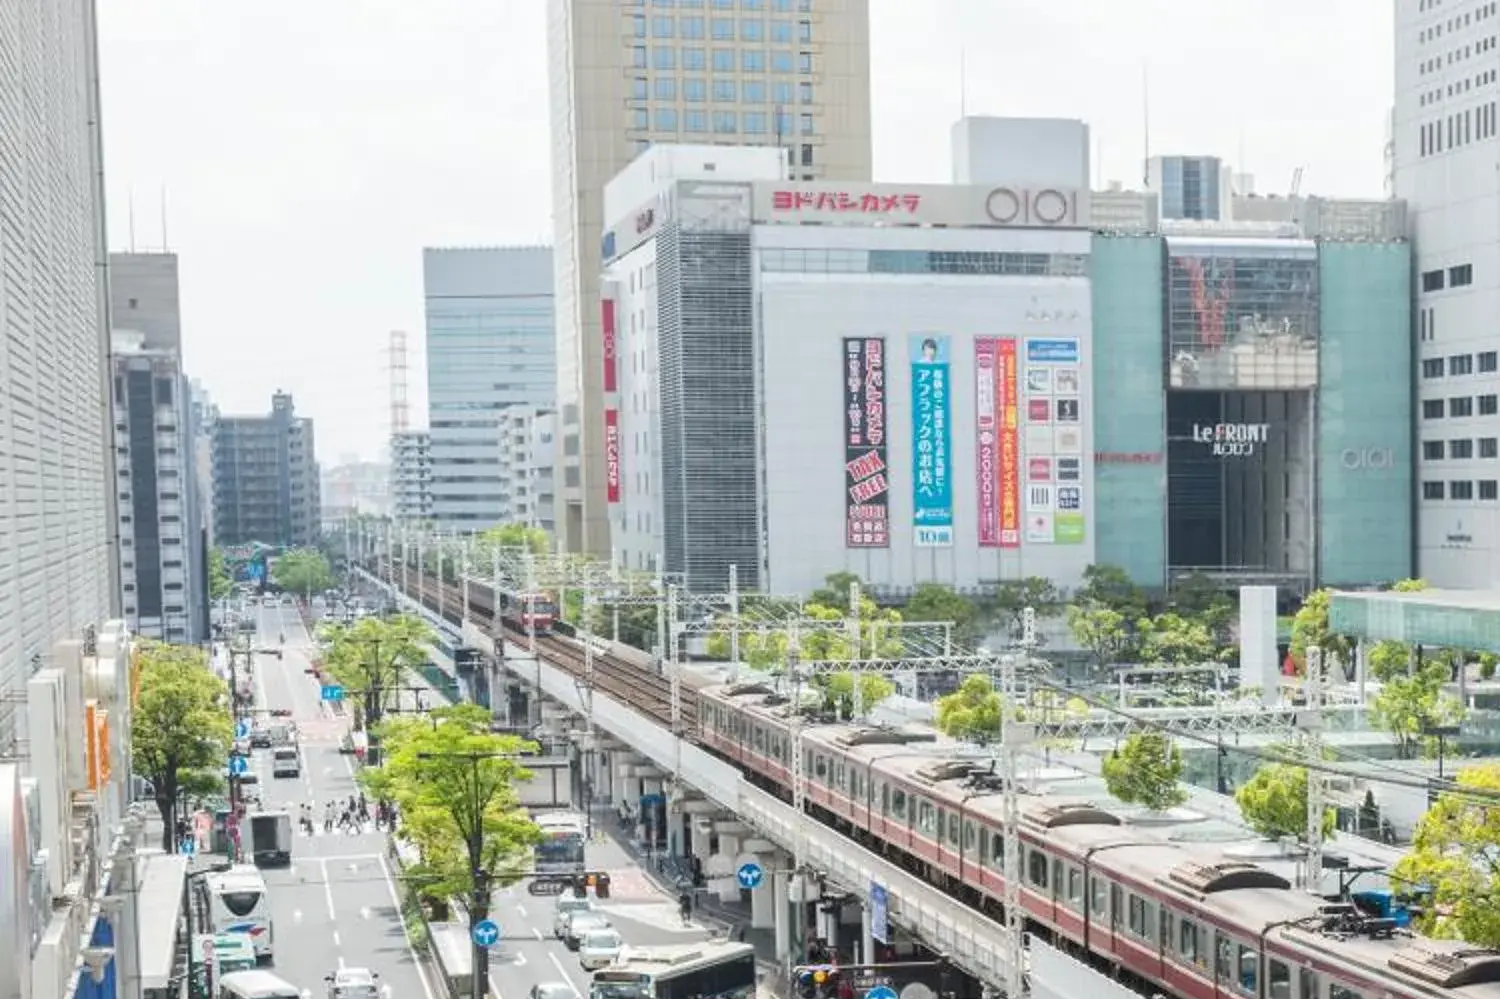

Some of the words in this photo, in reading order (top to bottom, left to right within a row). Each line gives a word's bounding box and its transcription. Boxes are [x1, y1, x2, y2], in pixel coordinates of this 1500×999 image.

[772, 190, 921, 214] ヨドバシカメラ
[917, 369, 933, 498] アフラックのお店へ
